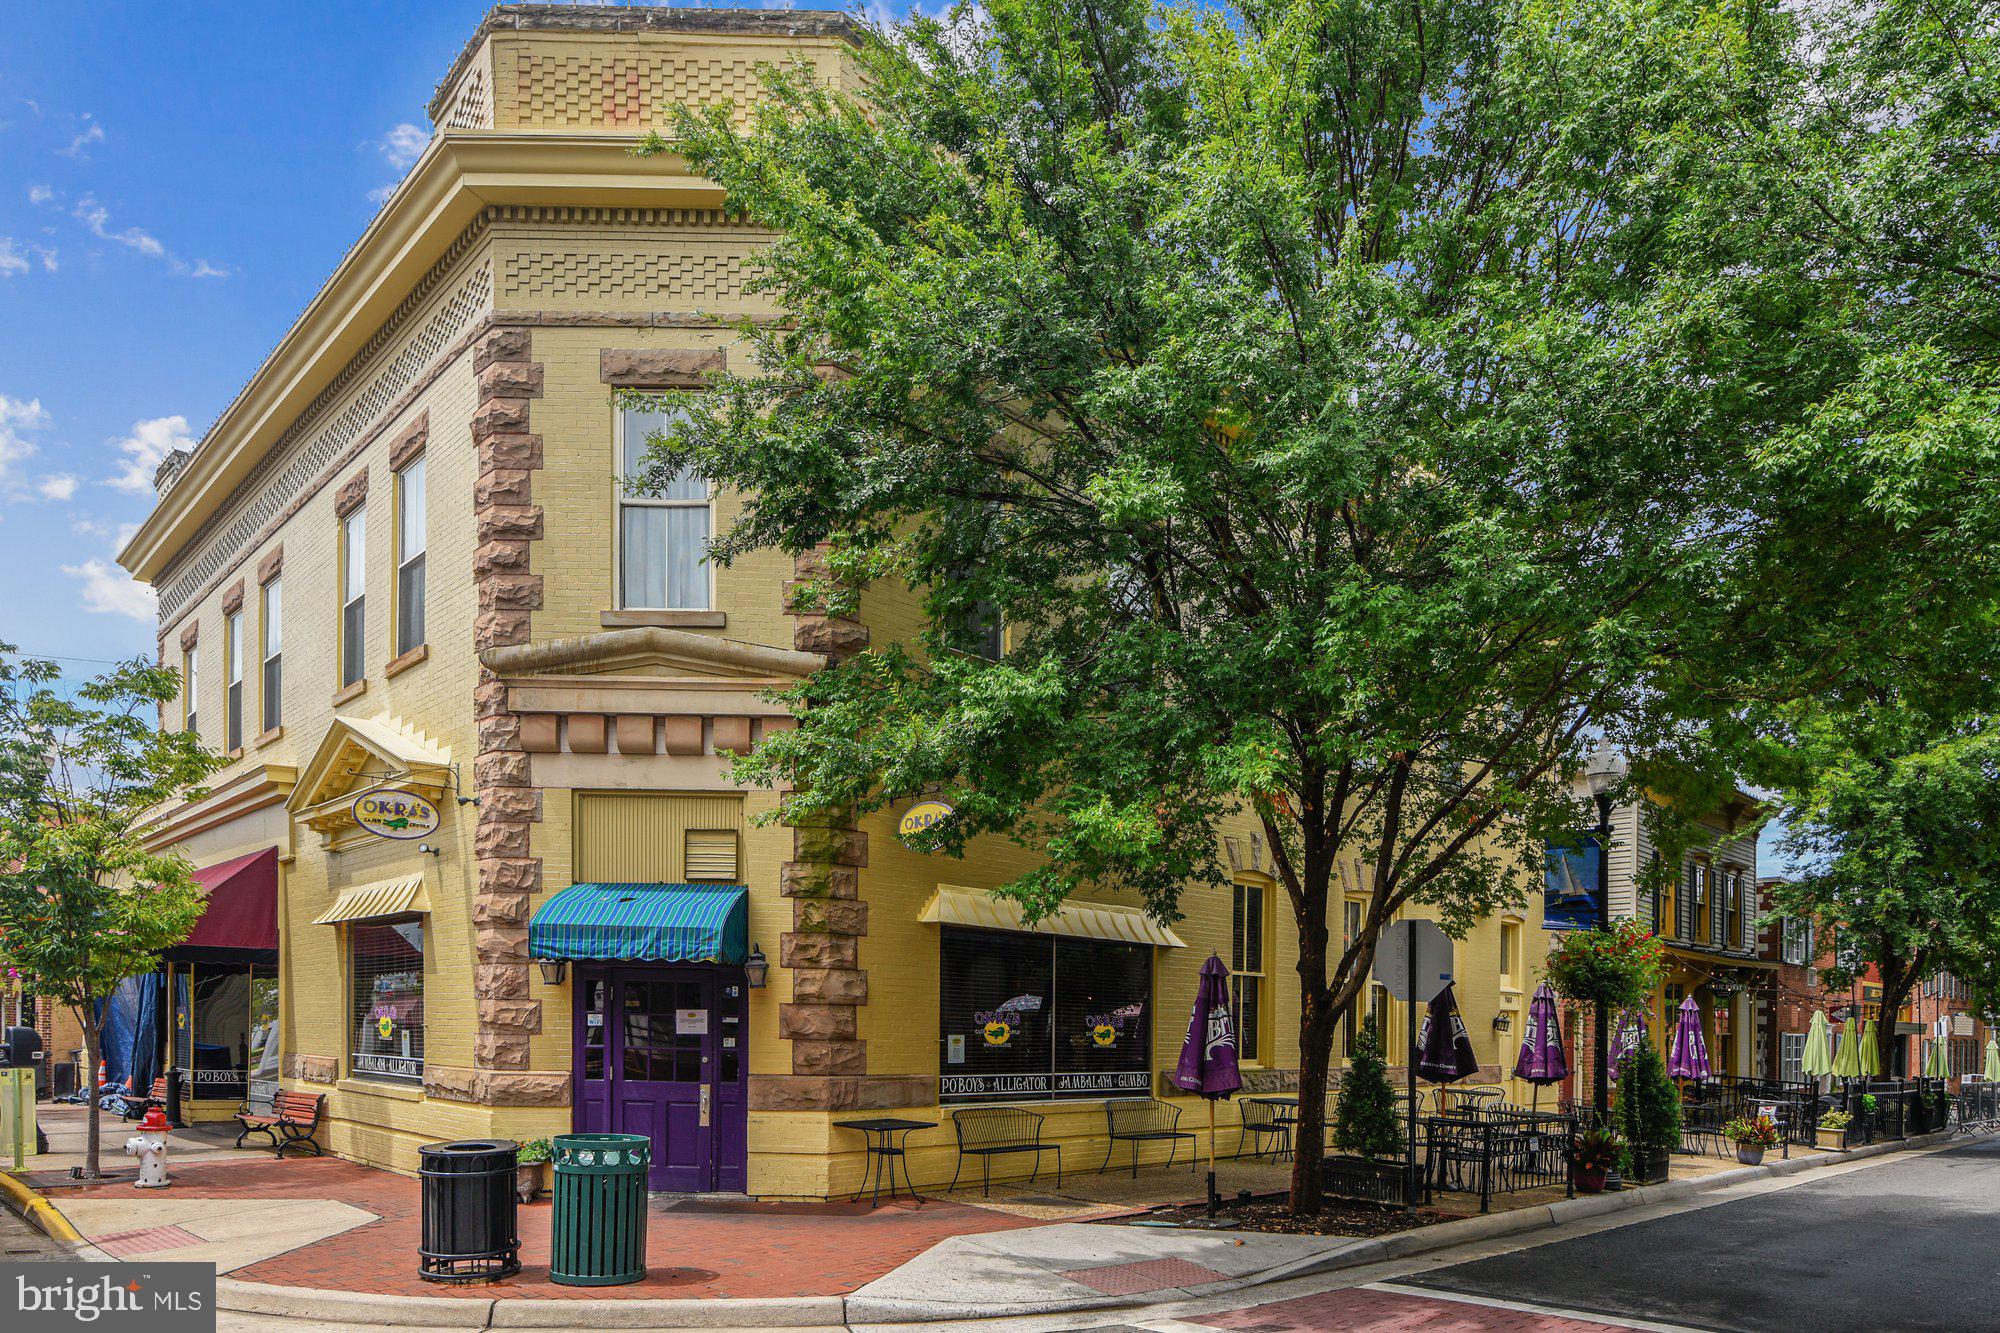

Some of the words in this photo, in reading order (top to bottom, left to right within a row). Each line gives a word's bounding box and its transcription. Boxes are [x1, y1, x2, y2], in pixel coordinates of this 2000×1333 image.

[364, 800, 430, 819] OKRA'S
[389, 1059, 417, 1075] ALLIGATOR
[942, 1077, 985, 1093] PO'BOYS
[993, 1077, 1047, 1091] ALLIGATOR
[1058, 1075, 1113, 1089] JAMBALAYA
[1118, 1074, 1148, 1087] GUMBO
